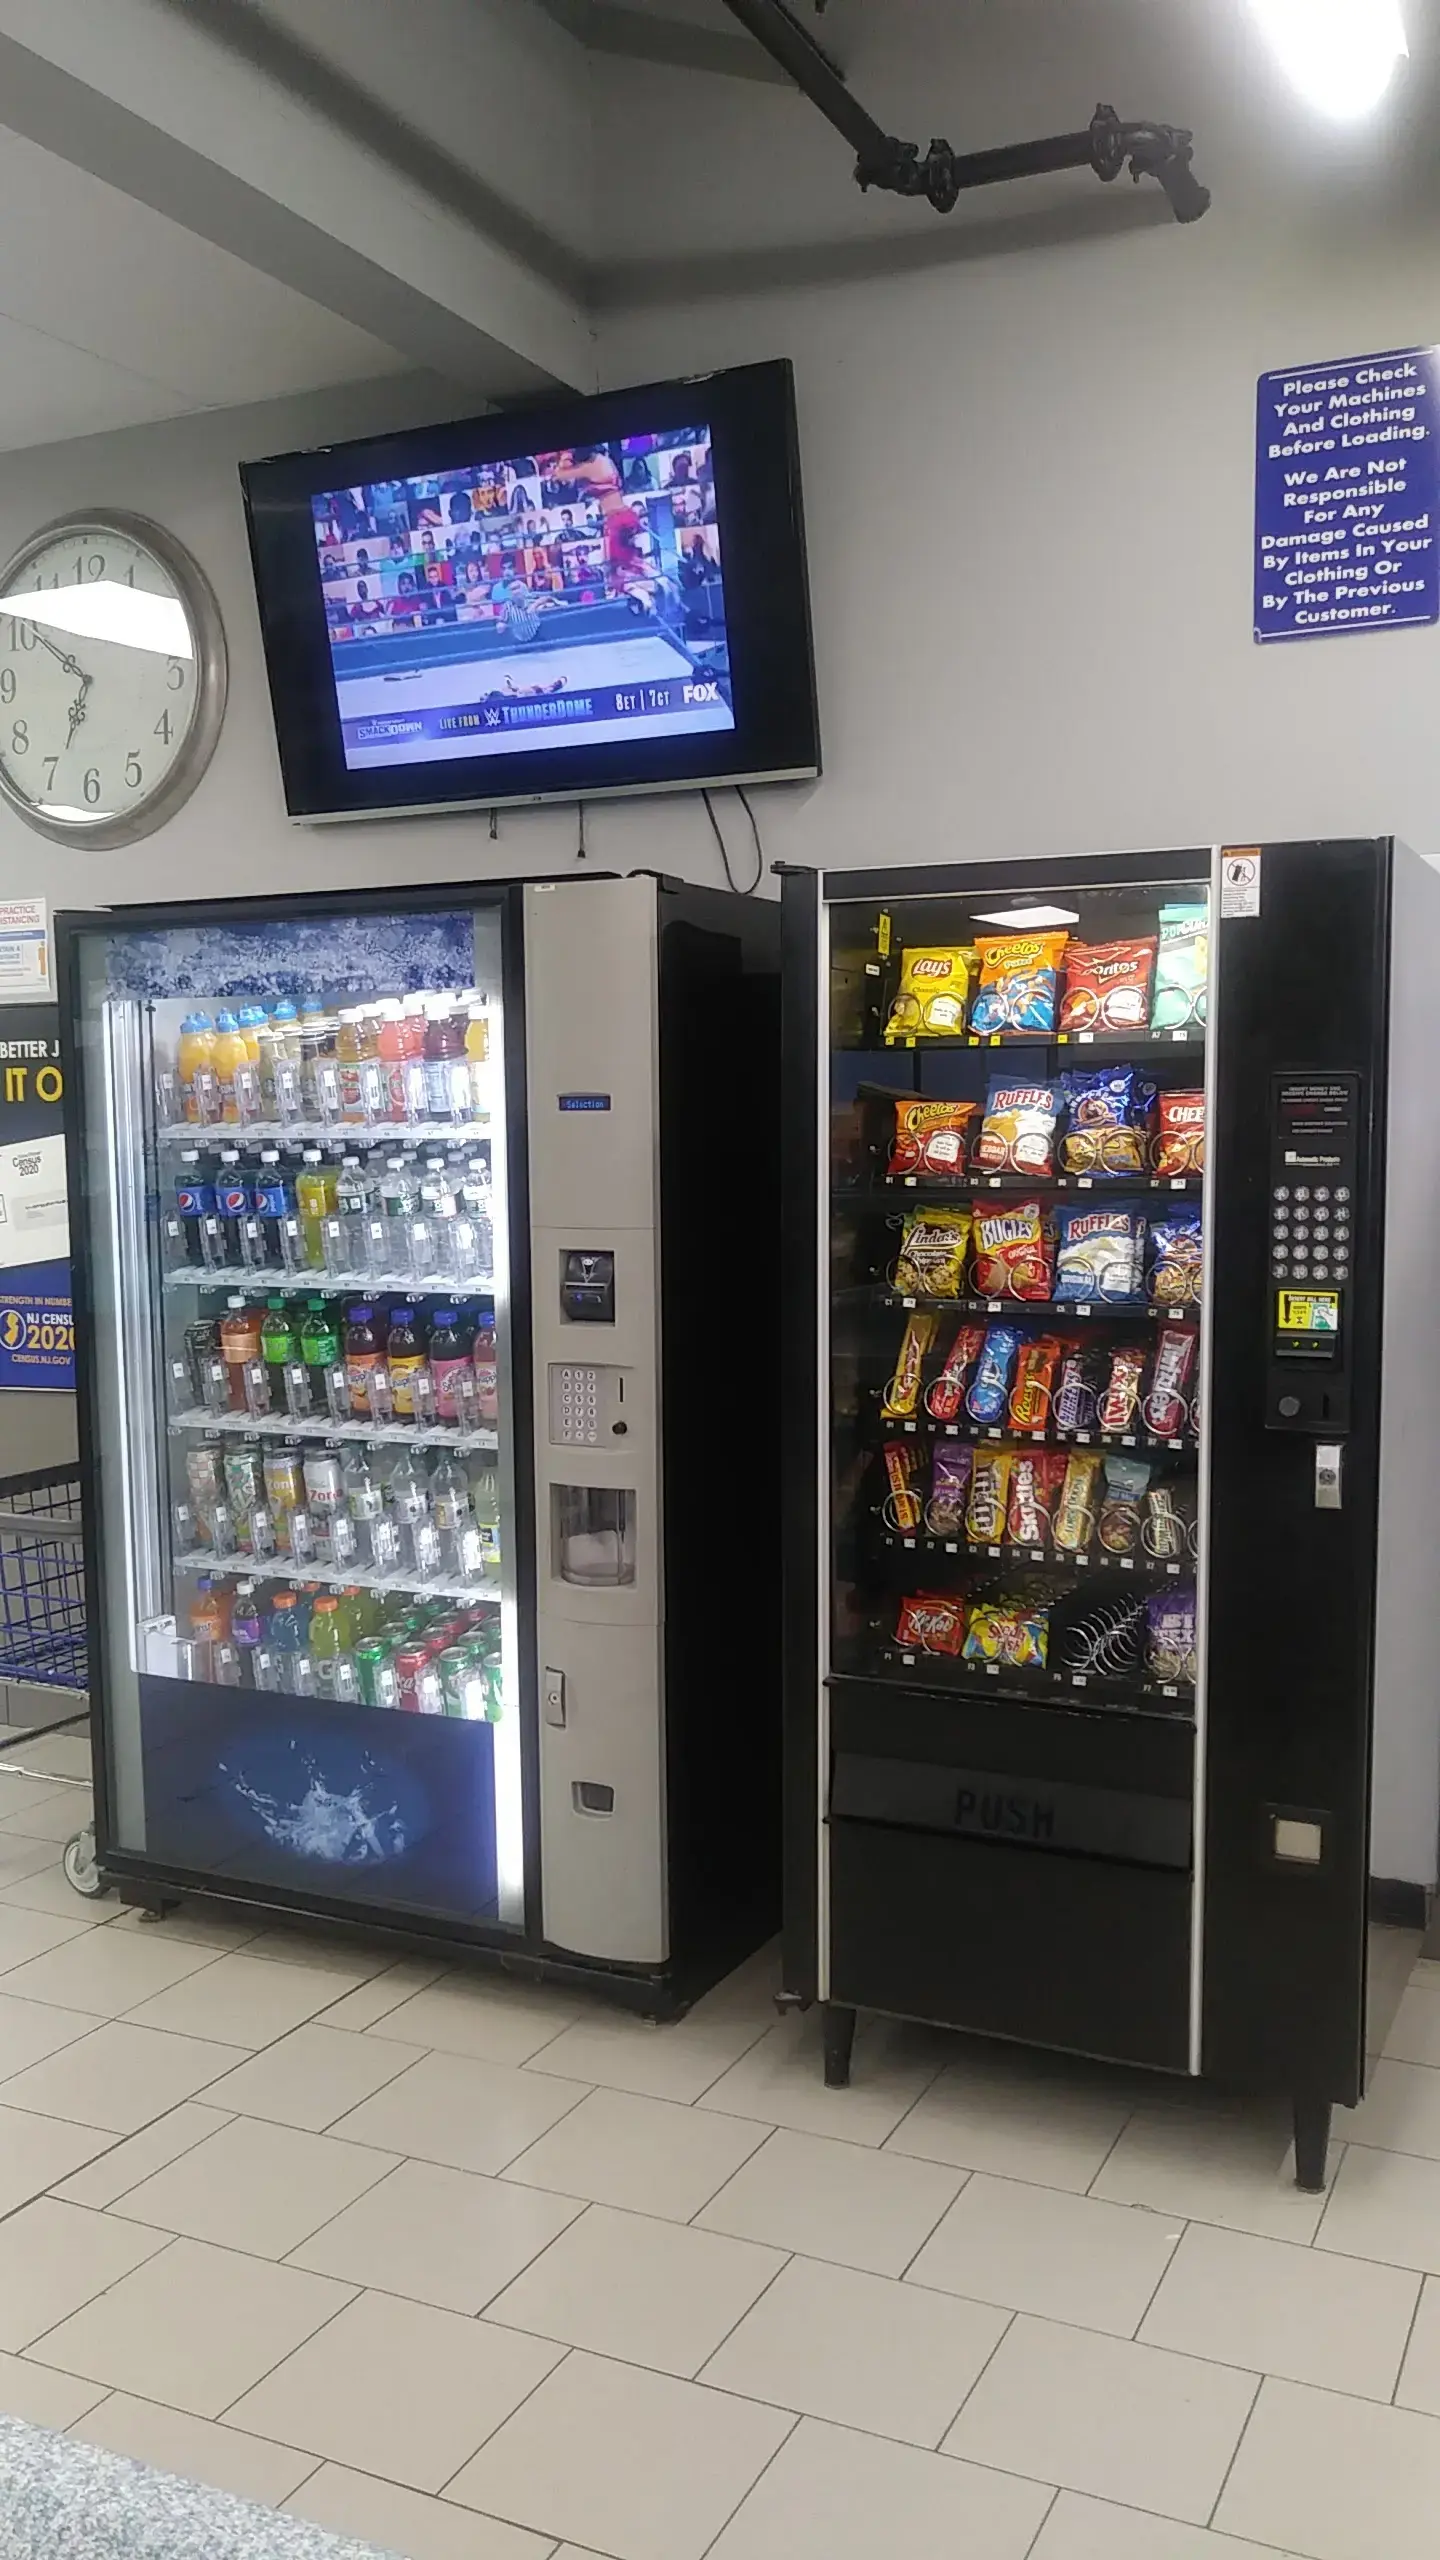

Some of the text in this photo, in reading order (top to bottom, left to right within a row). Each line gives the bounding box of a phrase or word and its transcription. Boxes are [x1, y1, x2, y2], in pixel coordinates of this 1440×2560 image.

[1283, 362, 1417, 397] Please Check
[1274, 383, 1427, 418] Your Machines
[1283, 404, 1416, 437] And Clothing
[1268, 424, 1431, 459] Before Loading.
[1284, 457, 1407, 487] We Are Not
[1283, 478, 1407, 509] Responsible
[1304, 502, 1385, 525] For Any
[1261, 513, 1429, 551] Damage Caused
[1263, 537, 1433, 572] By Items In Your
[1284, 558, 1403, 587] Clothing Or
[1262, 577, 1425, 611] By The Previous
[1294, 603, 1396, 625] Customer.
[682, 682, 718, 704] FOX
[12, 719, 30, 755] 8
[153, 708, 174, 745] 4
[439, 717, 457, 730] LIVE
[458, 714, 480, 729] FROM
[42, 756, 60, 791] 7
[124, 749, 143, 788] 5
[83, 768, 101, 804] 6
[0, 905, 36, 915] PRACTICE
[986, 942, 1042, 965] Cheetos
[0, 1040, 48, 1059] BETTER
[5, 1067, 28, 1102] IT
[994, 1089, 1053, 1110] RUFFLES
[906, 1103, 957, 1131] Cheetos
[12, 1155, 42, 1168] Census
[19, 1164, 39, 1177] 2020
[980, 1218, 1034, 1250] BUGLES
[1068, 1214, 1130, 1241] RUFFLES
[27, 1312, 40, 1324] NJ
[954, 1789, 1056, 1840] PUSH
